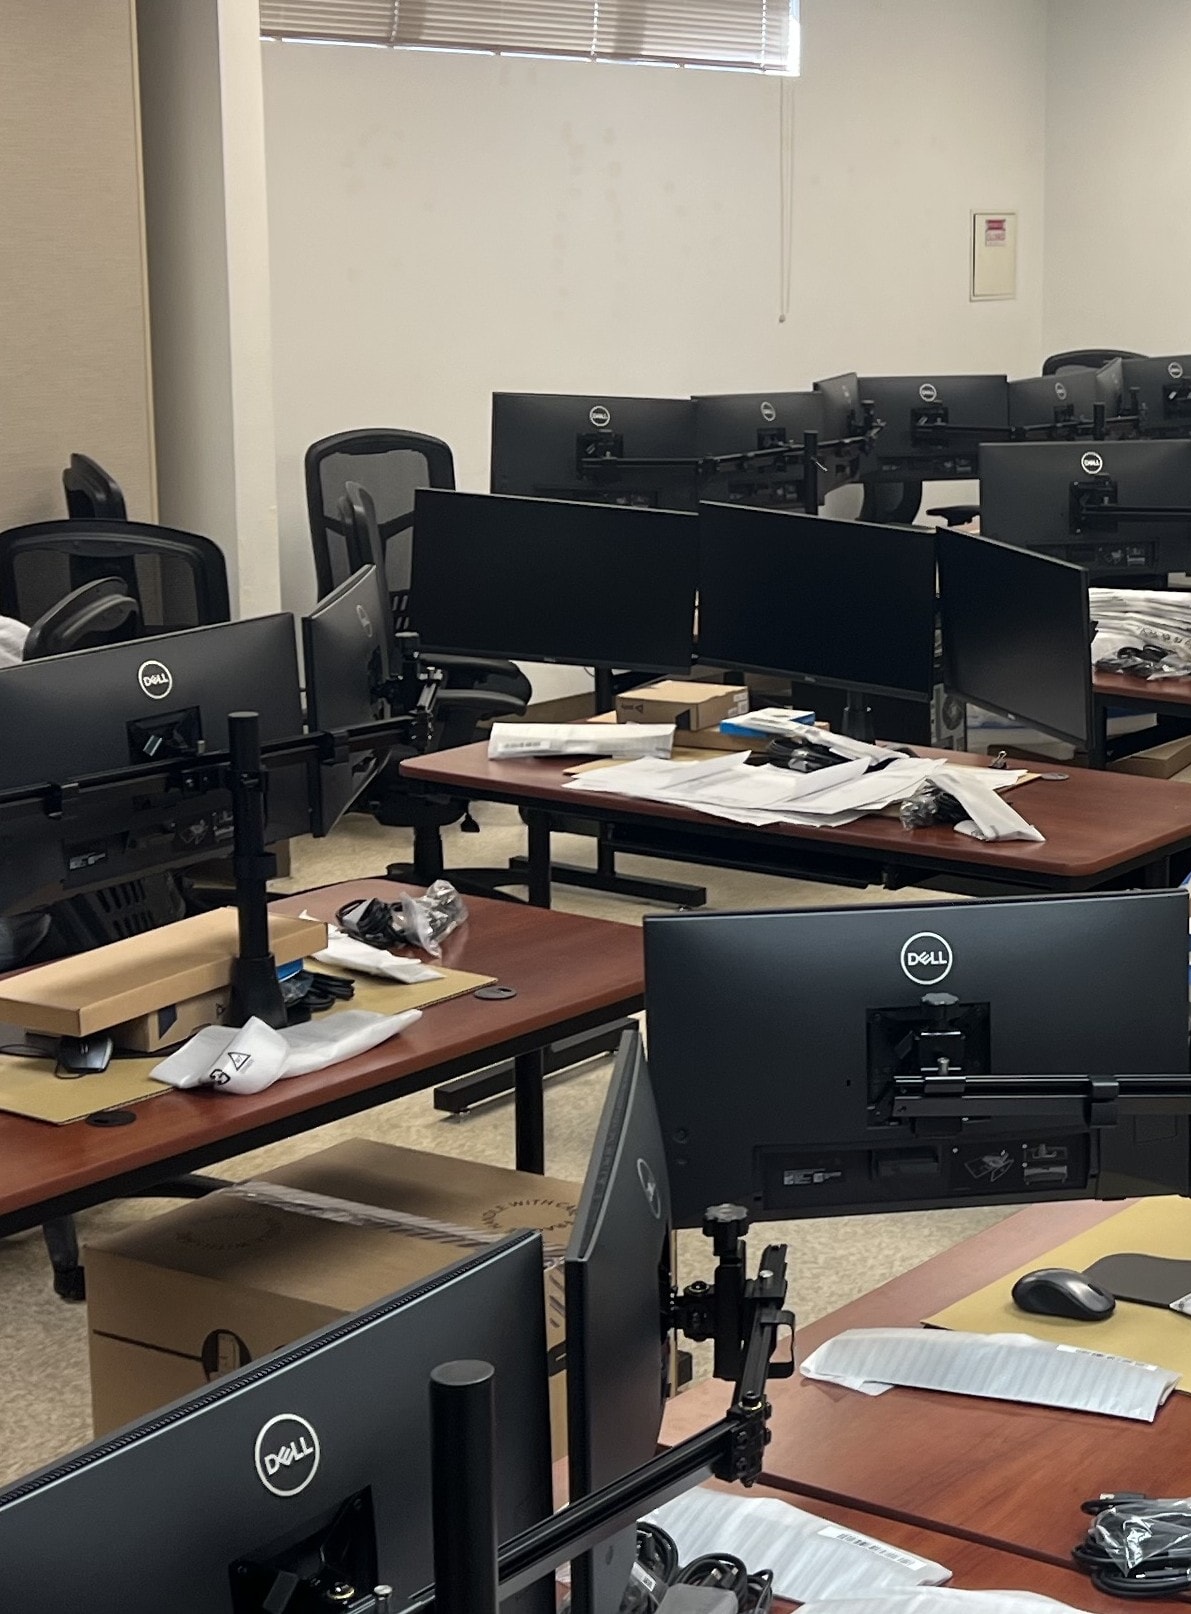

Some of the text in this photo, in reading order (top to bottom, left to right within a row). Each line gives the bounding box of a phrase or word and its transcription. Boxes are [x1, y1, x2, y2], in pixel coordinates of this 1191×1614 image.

[143, 672, 169, 688] DELL
[907, 950, 948, 966] DELL
[263, 1436, 314, 1476] DELL
